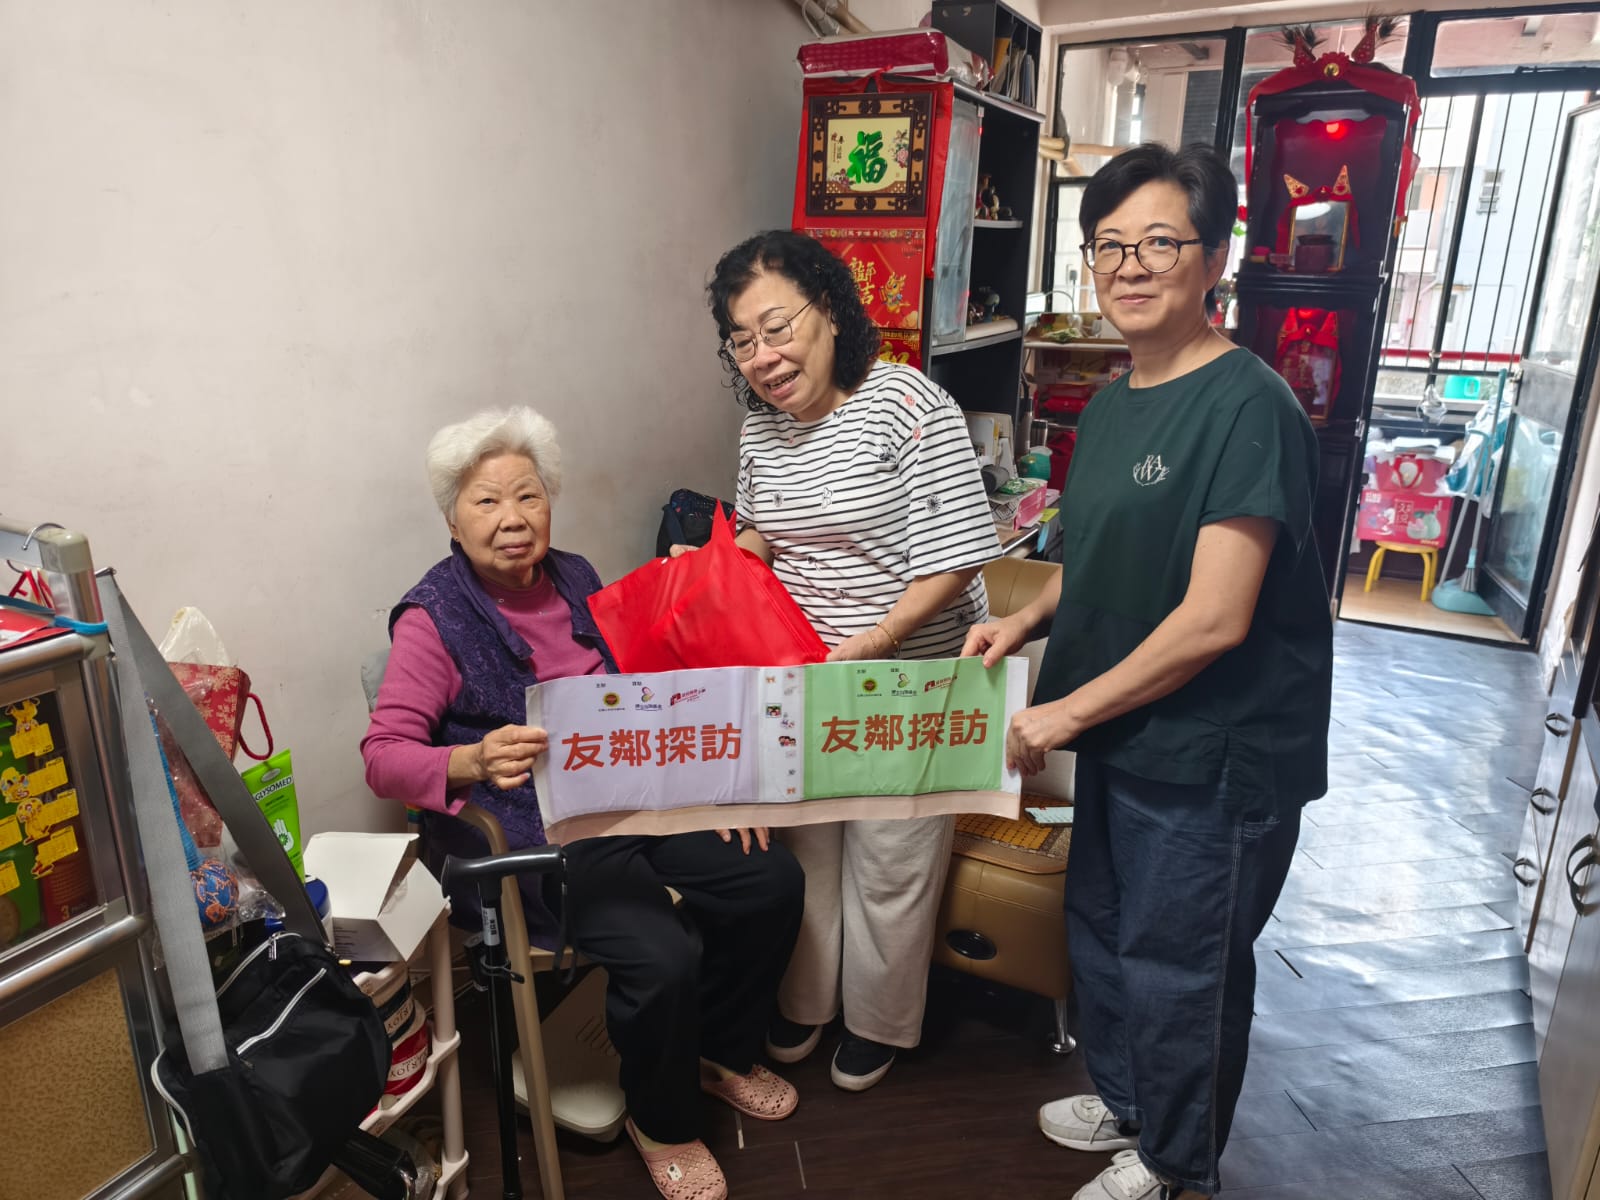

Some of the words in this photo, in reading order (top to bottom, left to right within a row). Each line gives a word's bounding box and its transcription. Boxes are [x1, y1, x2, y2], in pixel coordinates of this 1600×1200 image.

[846, 130, 888, 184] 福
[562, 723, 742, 772] 友鄰探訪
[821, 707, 989, 755] 友鄰探訪
[255, 776, 292, 801] GLYSOMED
